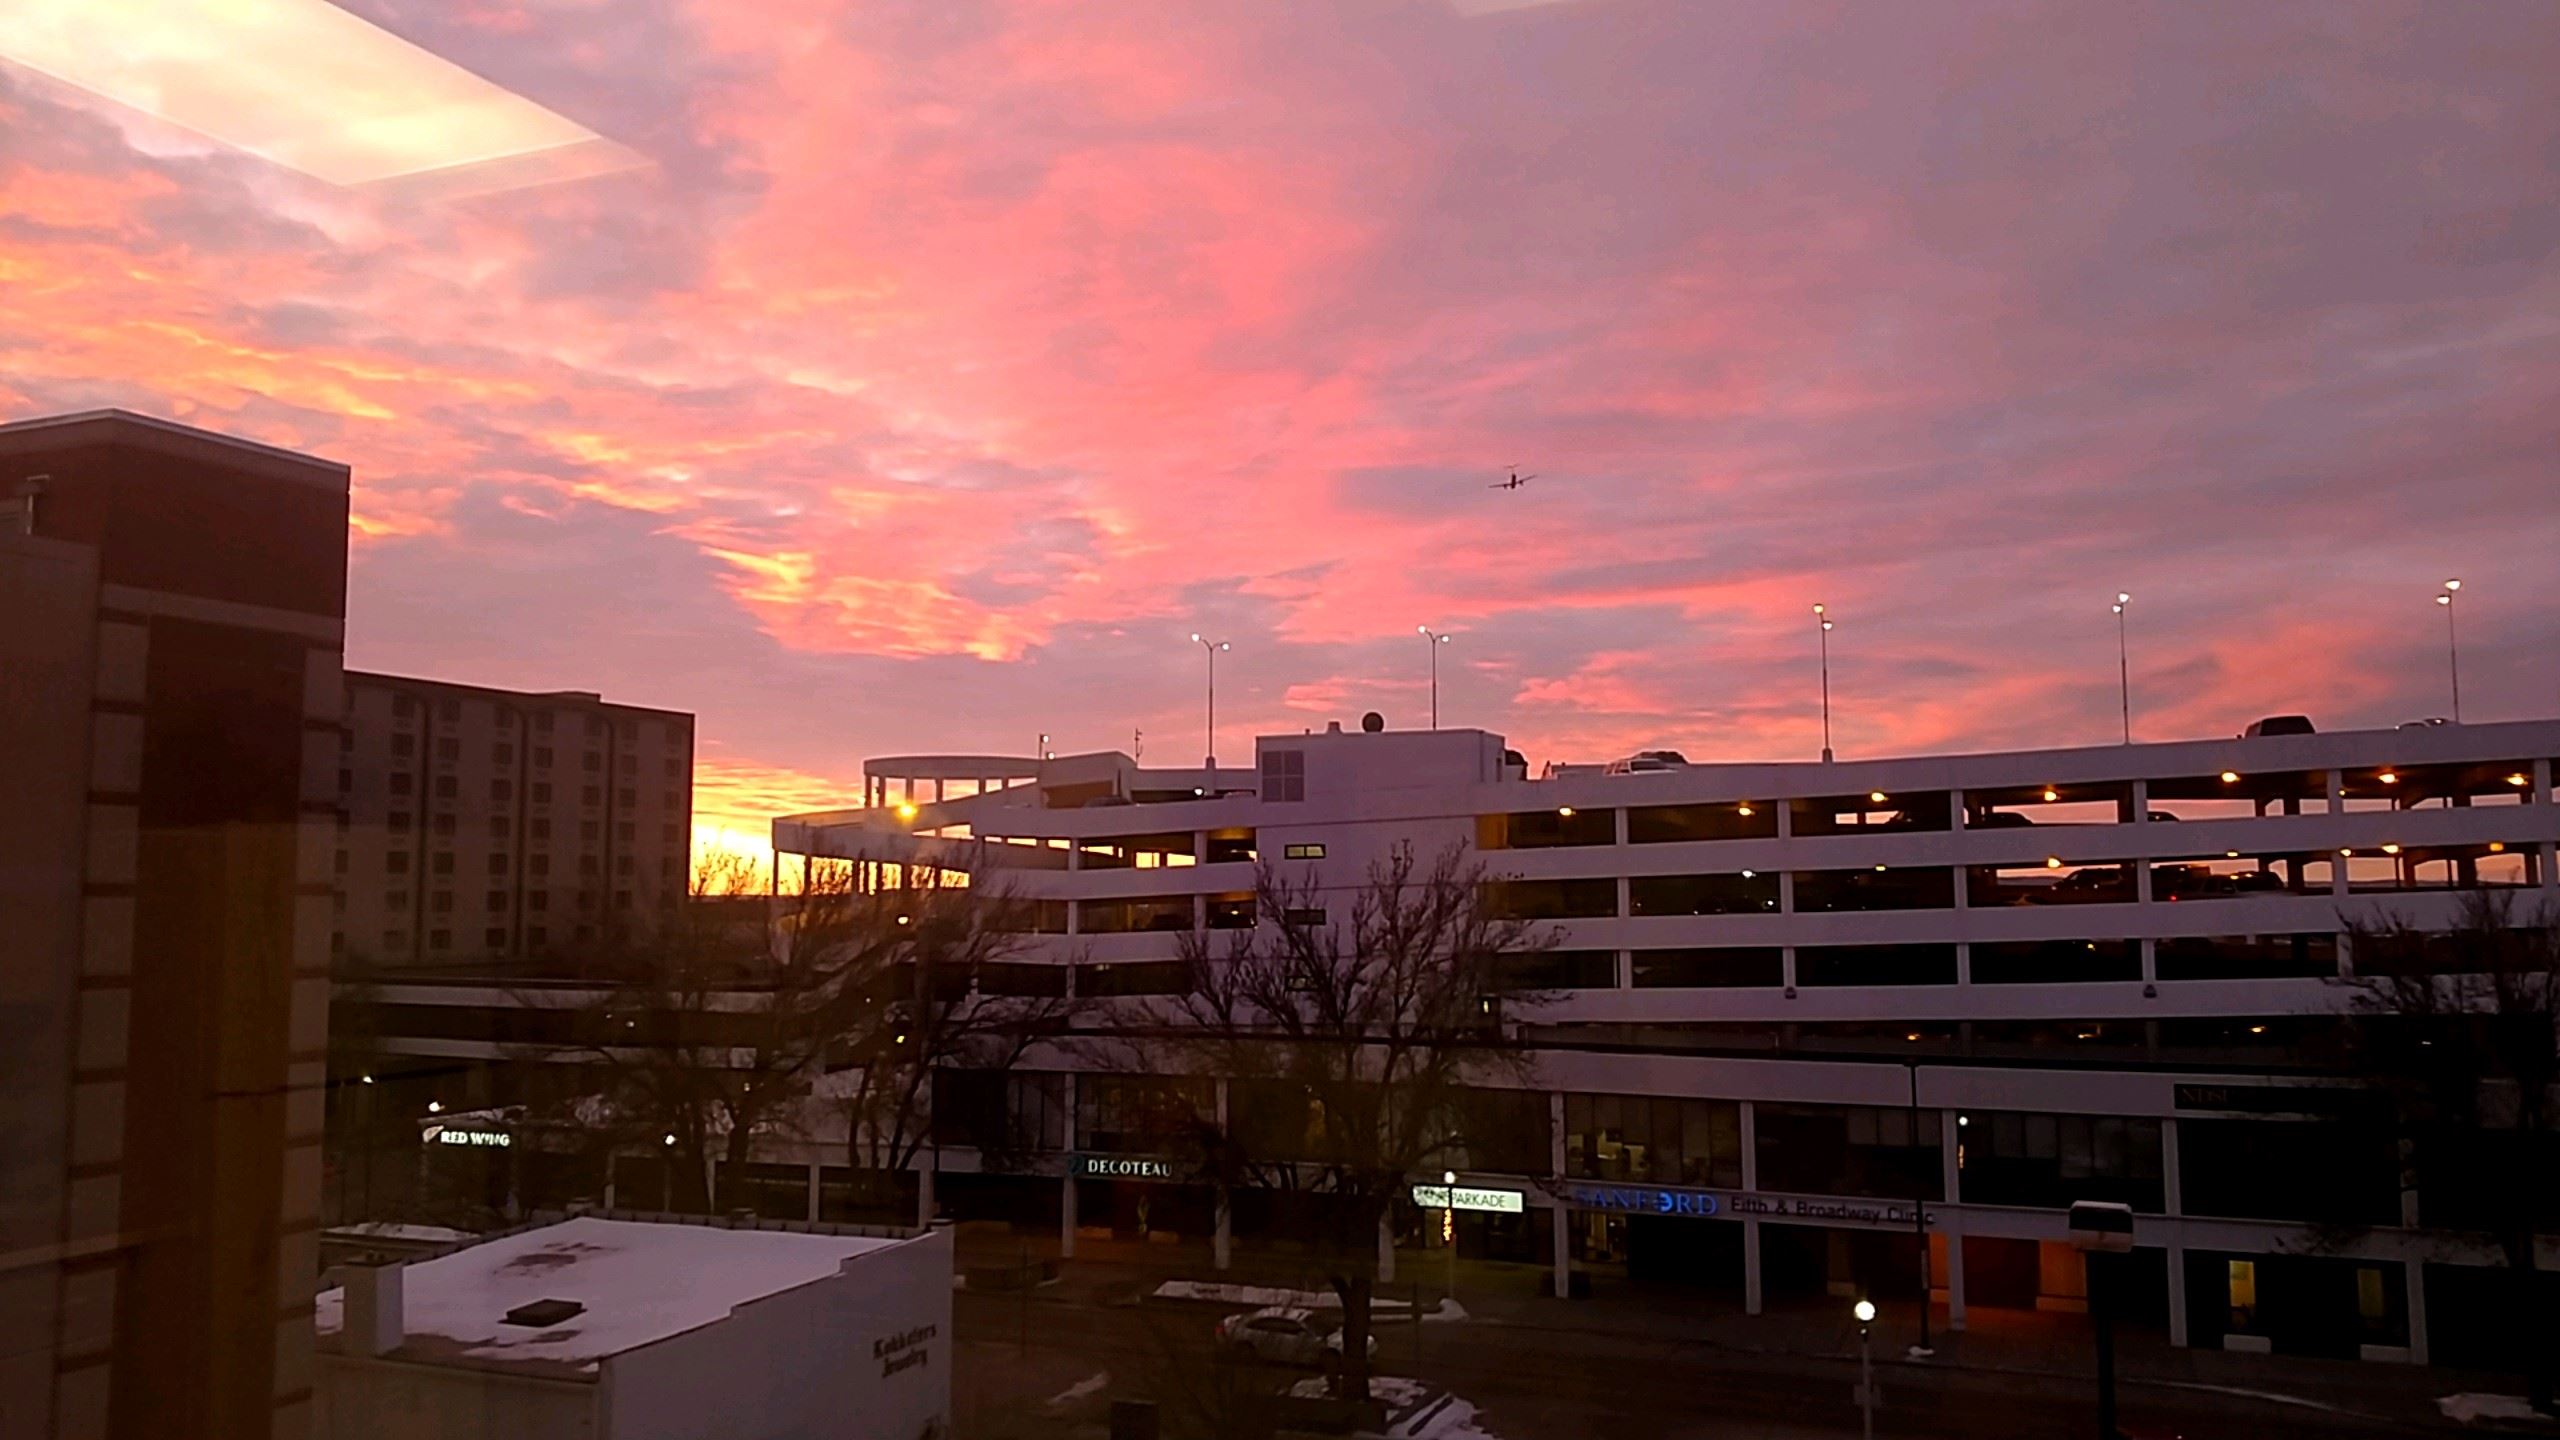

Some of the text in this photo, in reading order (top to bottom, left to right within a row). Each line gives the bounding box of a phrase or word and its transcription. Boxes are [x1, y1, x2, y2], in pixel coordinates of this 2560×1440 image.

[440, 1131, 468, 1144] RED
[1087, 1159, 1173, 1177] DECOTEAU
[1796, 1200, 1881, 1225] Broadway
